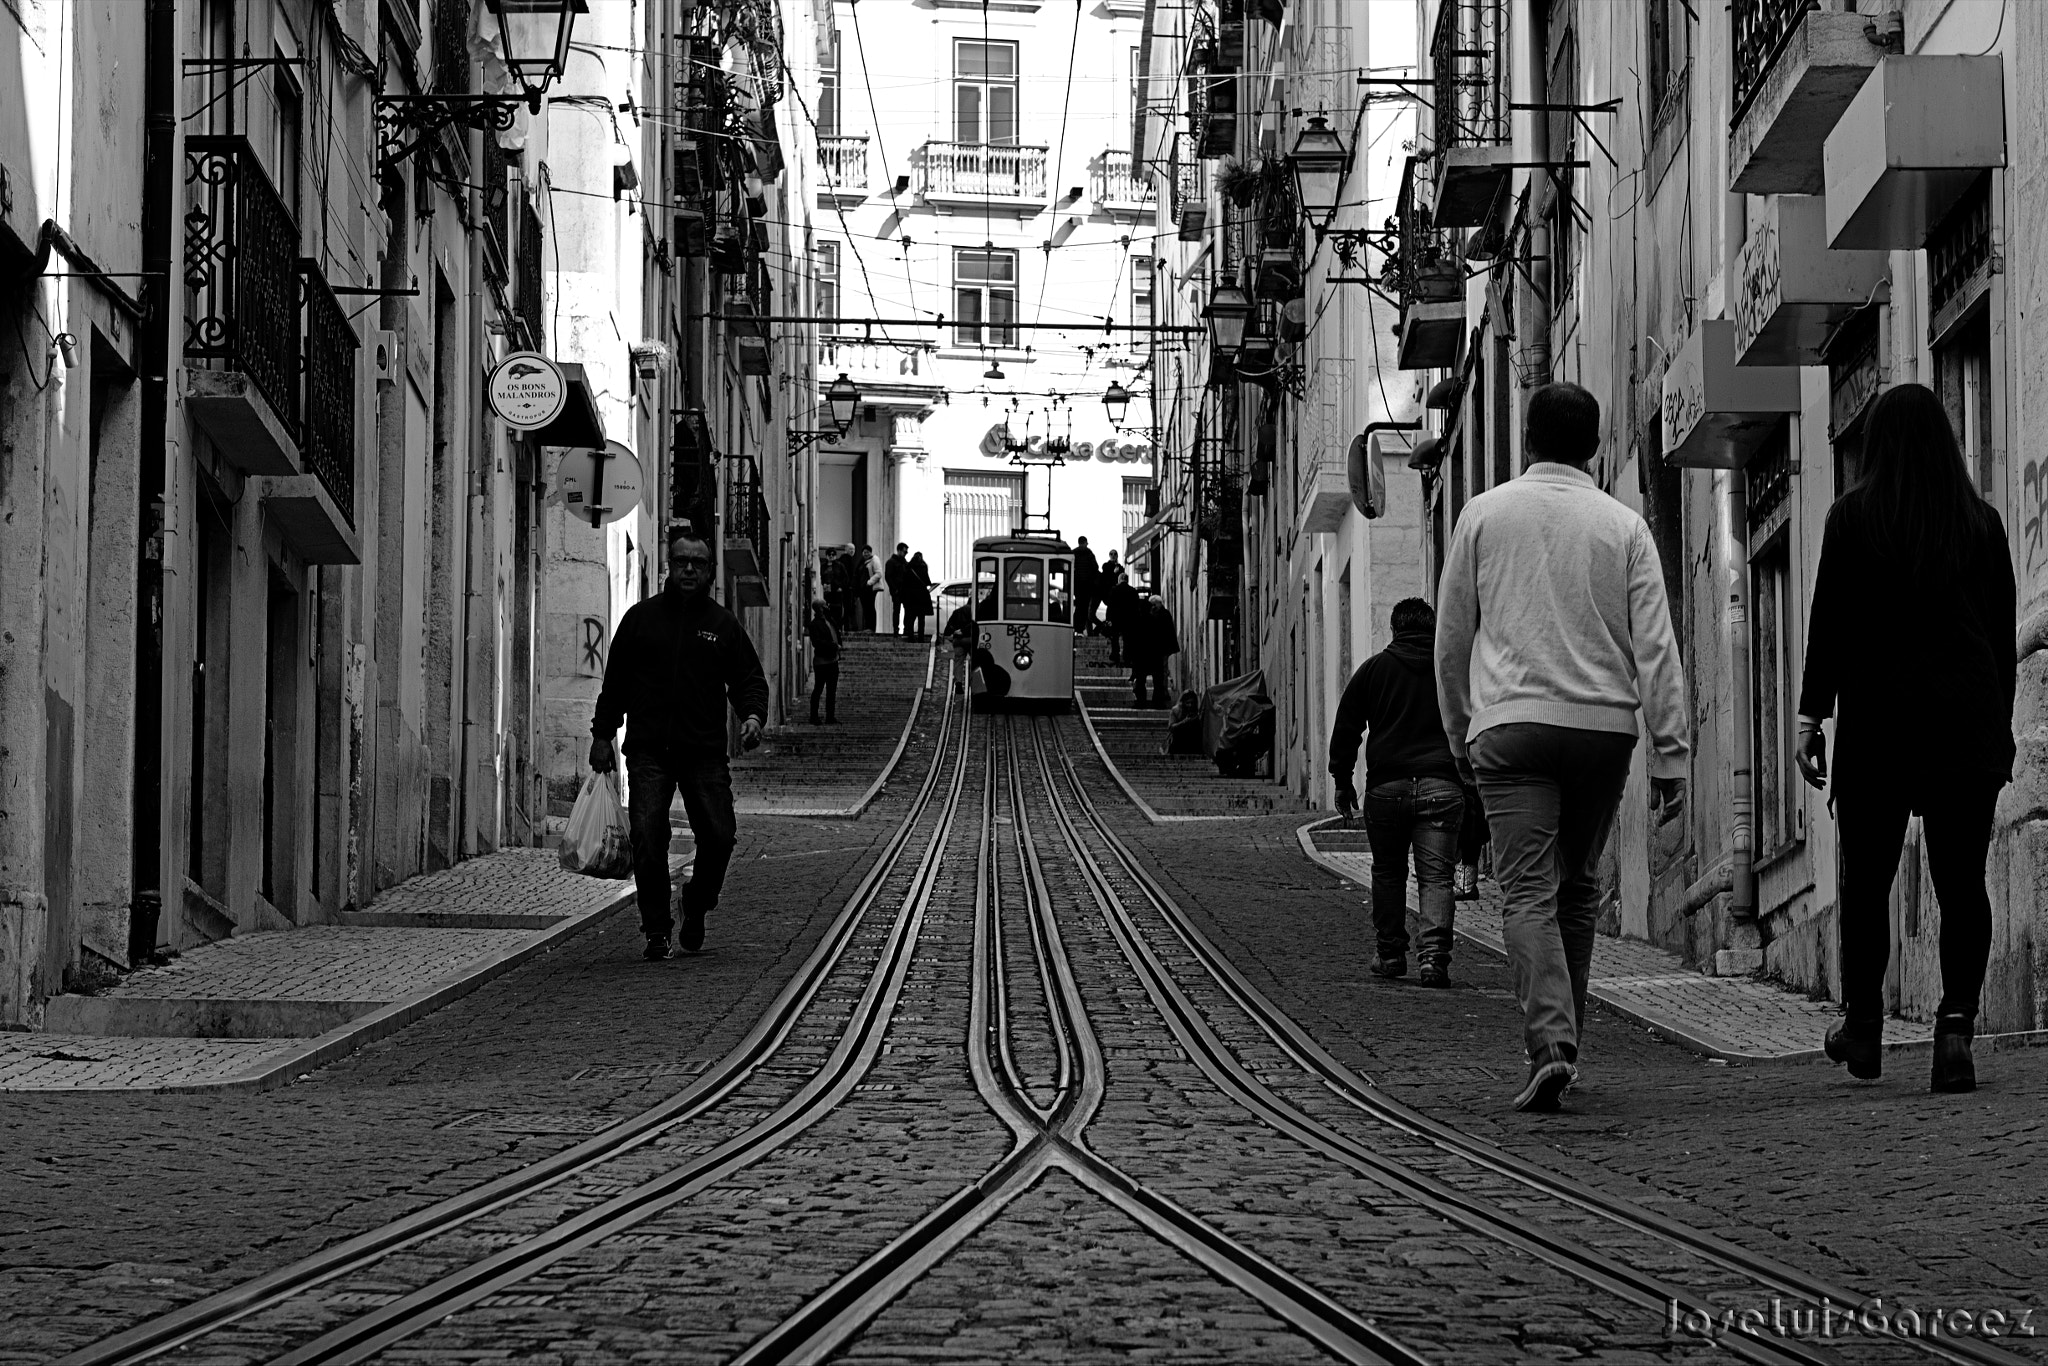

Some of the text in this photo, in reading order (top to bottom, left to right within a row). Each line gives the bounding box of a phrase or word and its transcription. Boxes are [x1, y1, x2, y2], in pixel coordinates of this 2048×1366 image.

[507, 383, 546, 391] OS BONS
[497, 391, 556, 399] MALANDROS
[508, 409, 546, 420] GASTROPUB
[1021, 435, 1094, 461] Caxa
